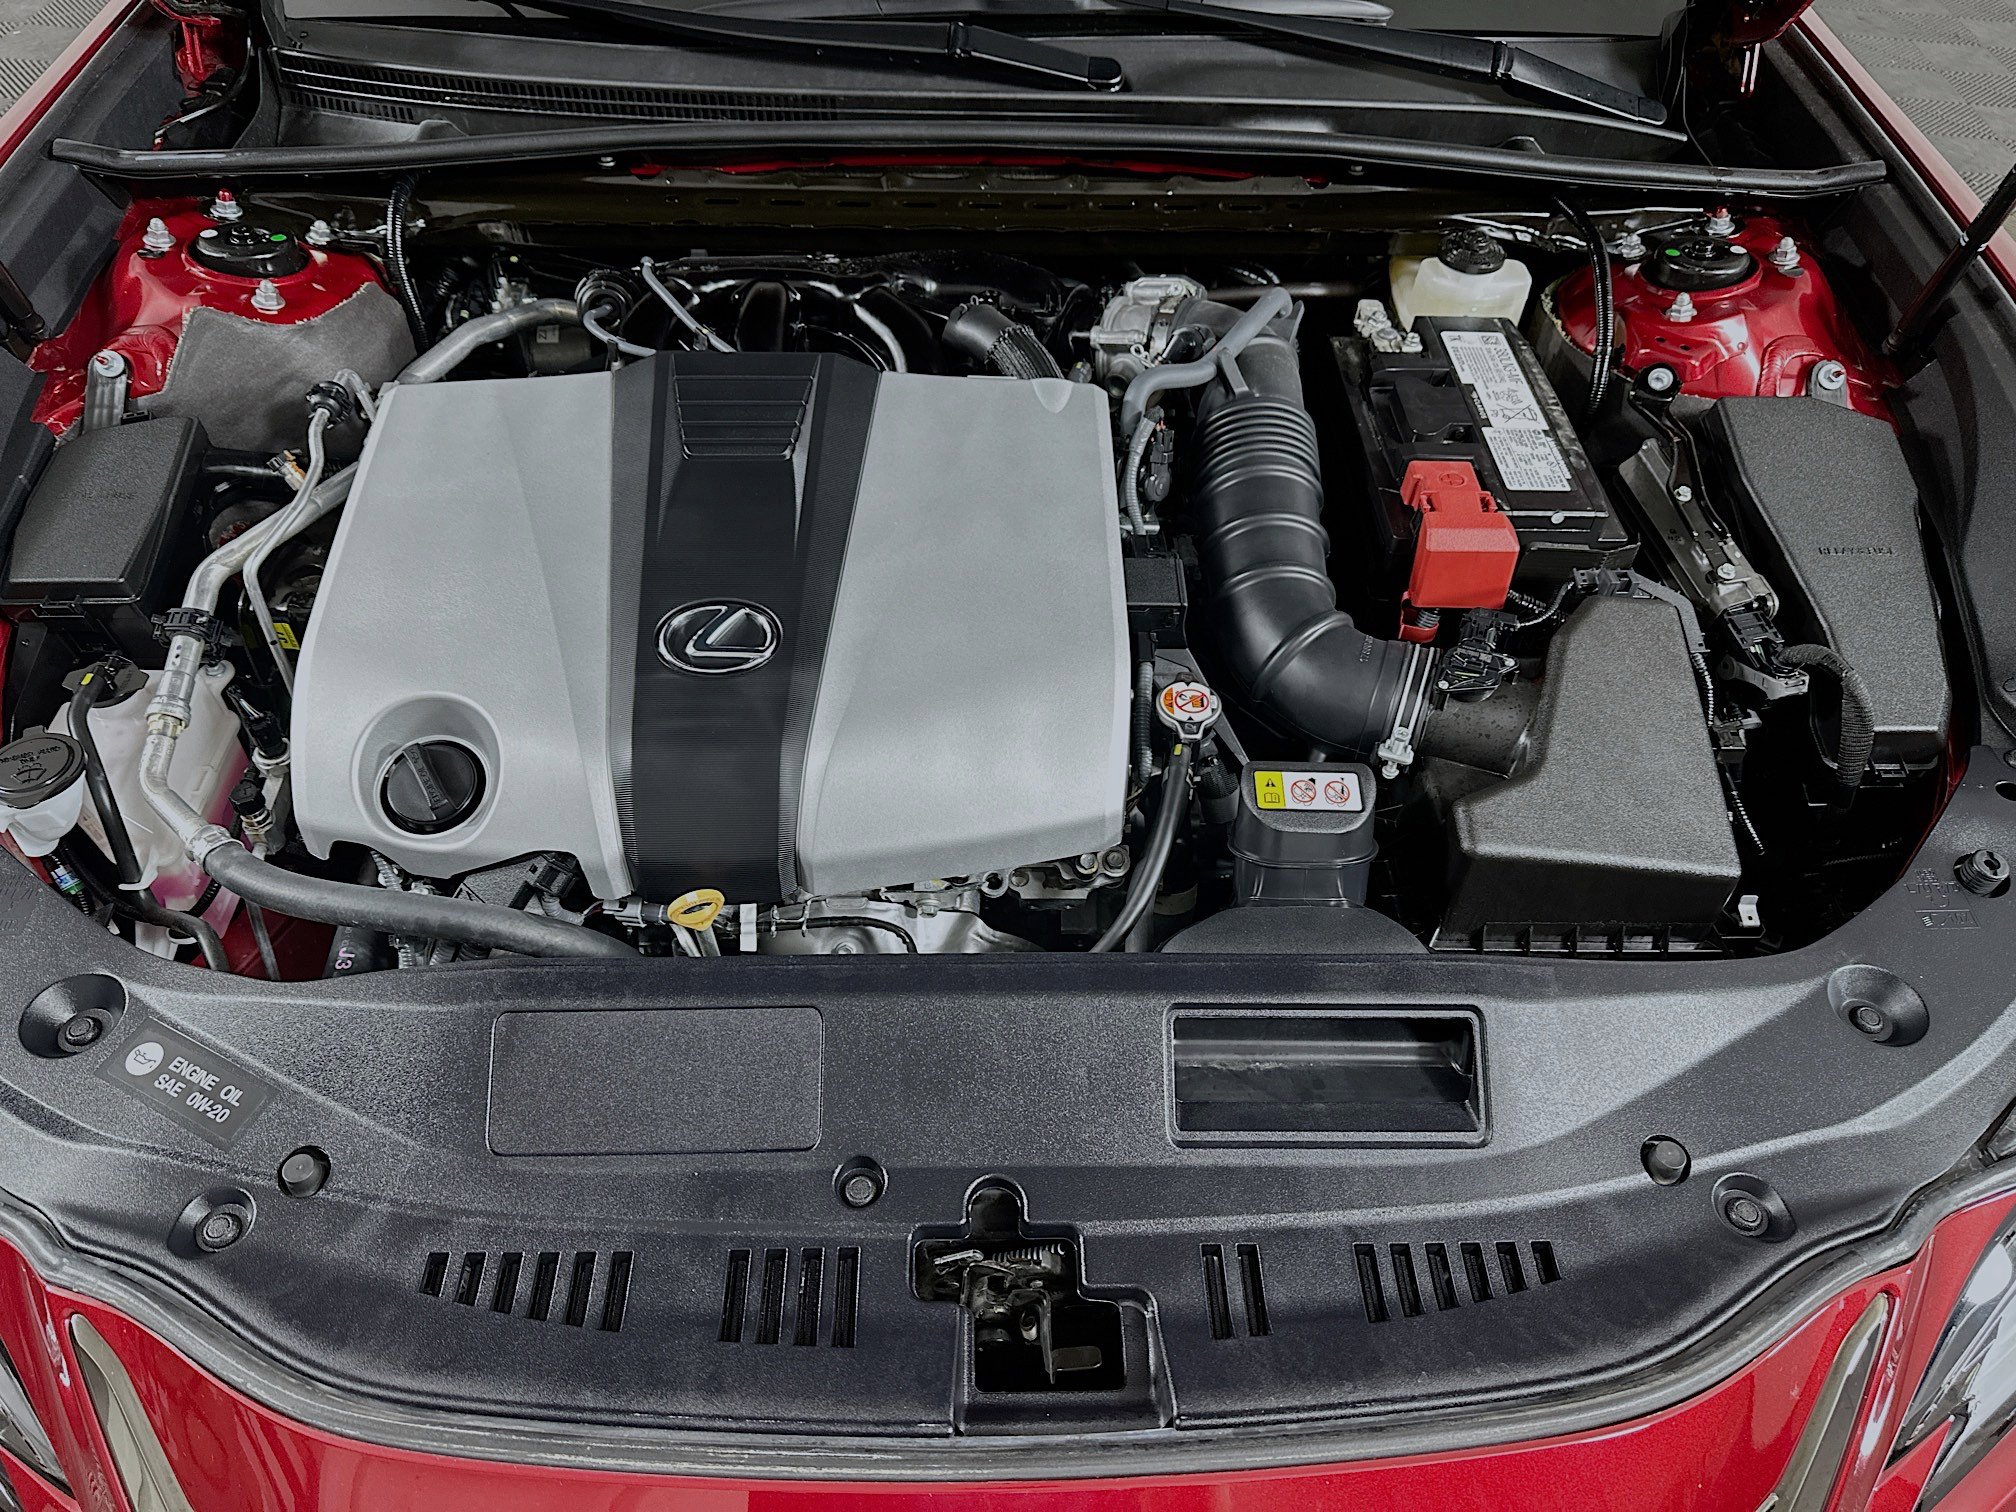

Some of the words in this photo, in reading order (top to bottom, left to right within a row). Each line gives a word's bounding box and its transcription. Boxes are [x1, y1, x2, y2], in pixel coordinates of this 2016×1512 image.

[153, 1073, 187, 1098] SAE
[186, 1091, 231, 1123] 0W-20
[168, 1056, 220, 1091] ENGINE
[220, 1085, 244, 1107] OIL
